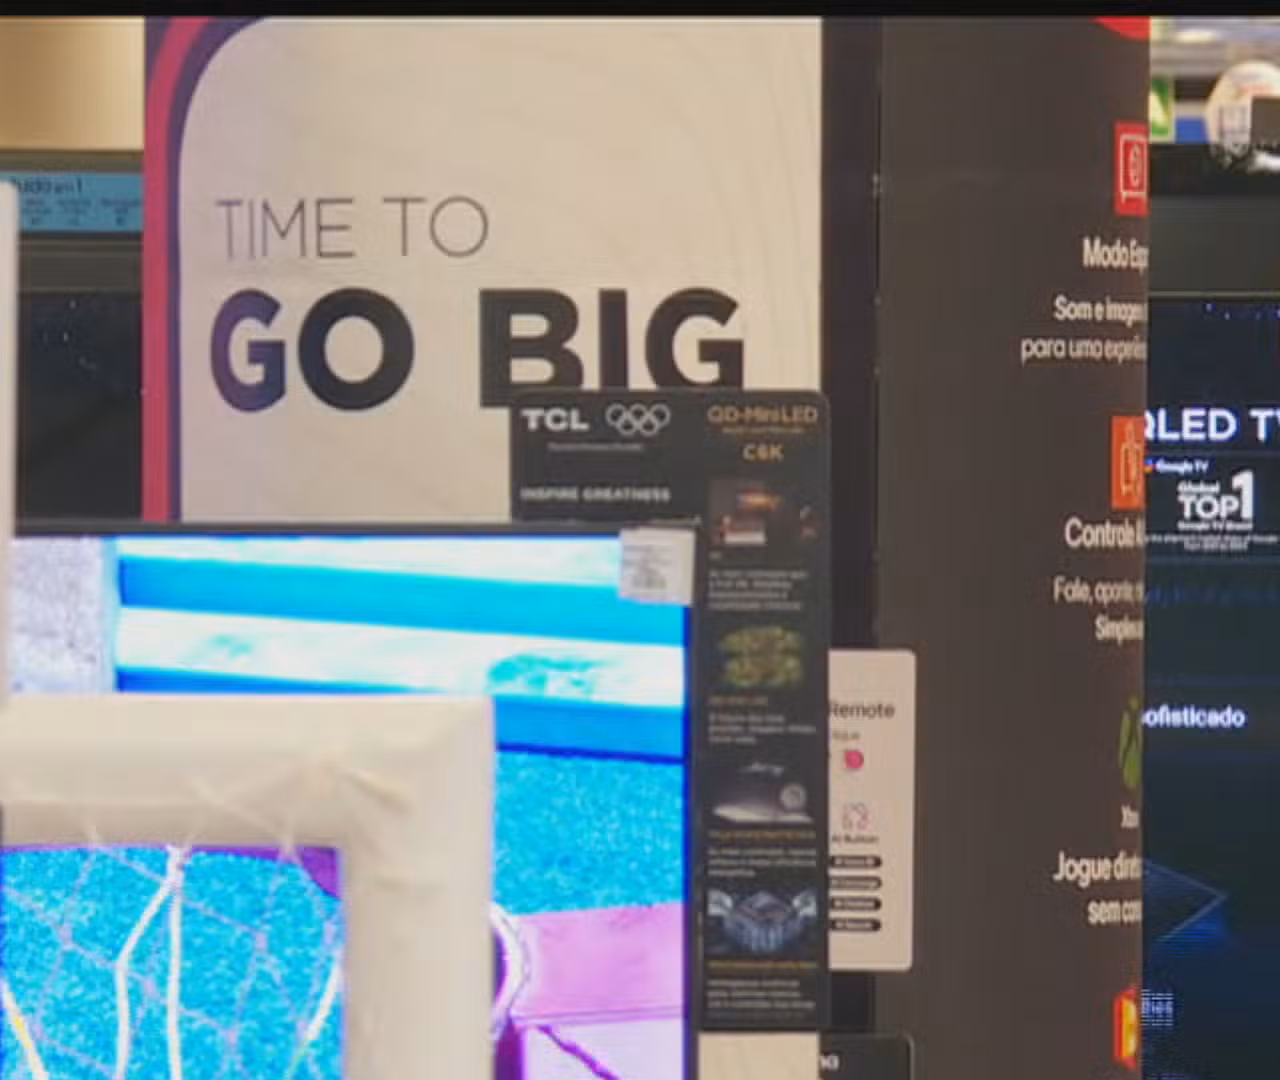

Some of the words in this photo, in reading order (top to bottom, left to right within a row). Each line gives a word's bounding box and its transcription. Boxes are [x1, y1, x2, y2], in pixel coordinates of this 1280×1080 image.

[216, 197, 355, 260] TIME
[383, 195, 490, 258] TO
[1083, 237, 1128, 268] Modo
[1054, 295, 1092, 321] Som
[210, 288, 414, 412] GO
[478, 288, 746, 408] BIG
[1021, 337, 1066, 366] para
[522, 407, 589, 431] TCL
[1177, 494, 1240, 520] TOP
[1231, 470, 1254, 519] 1
[1053, 851, 1111, 887] Jogue
